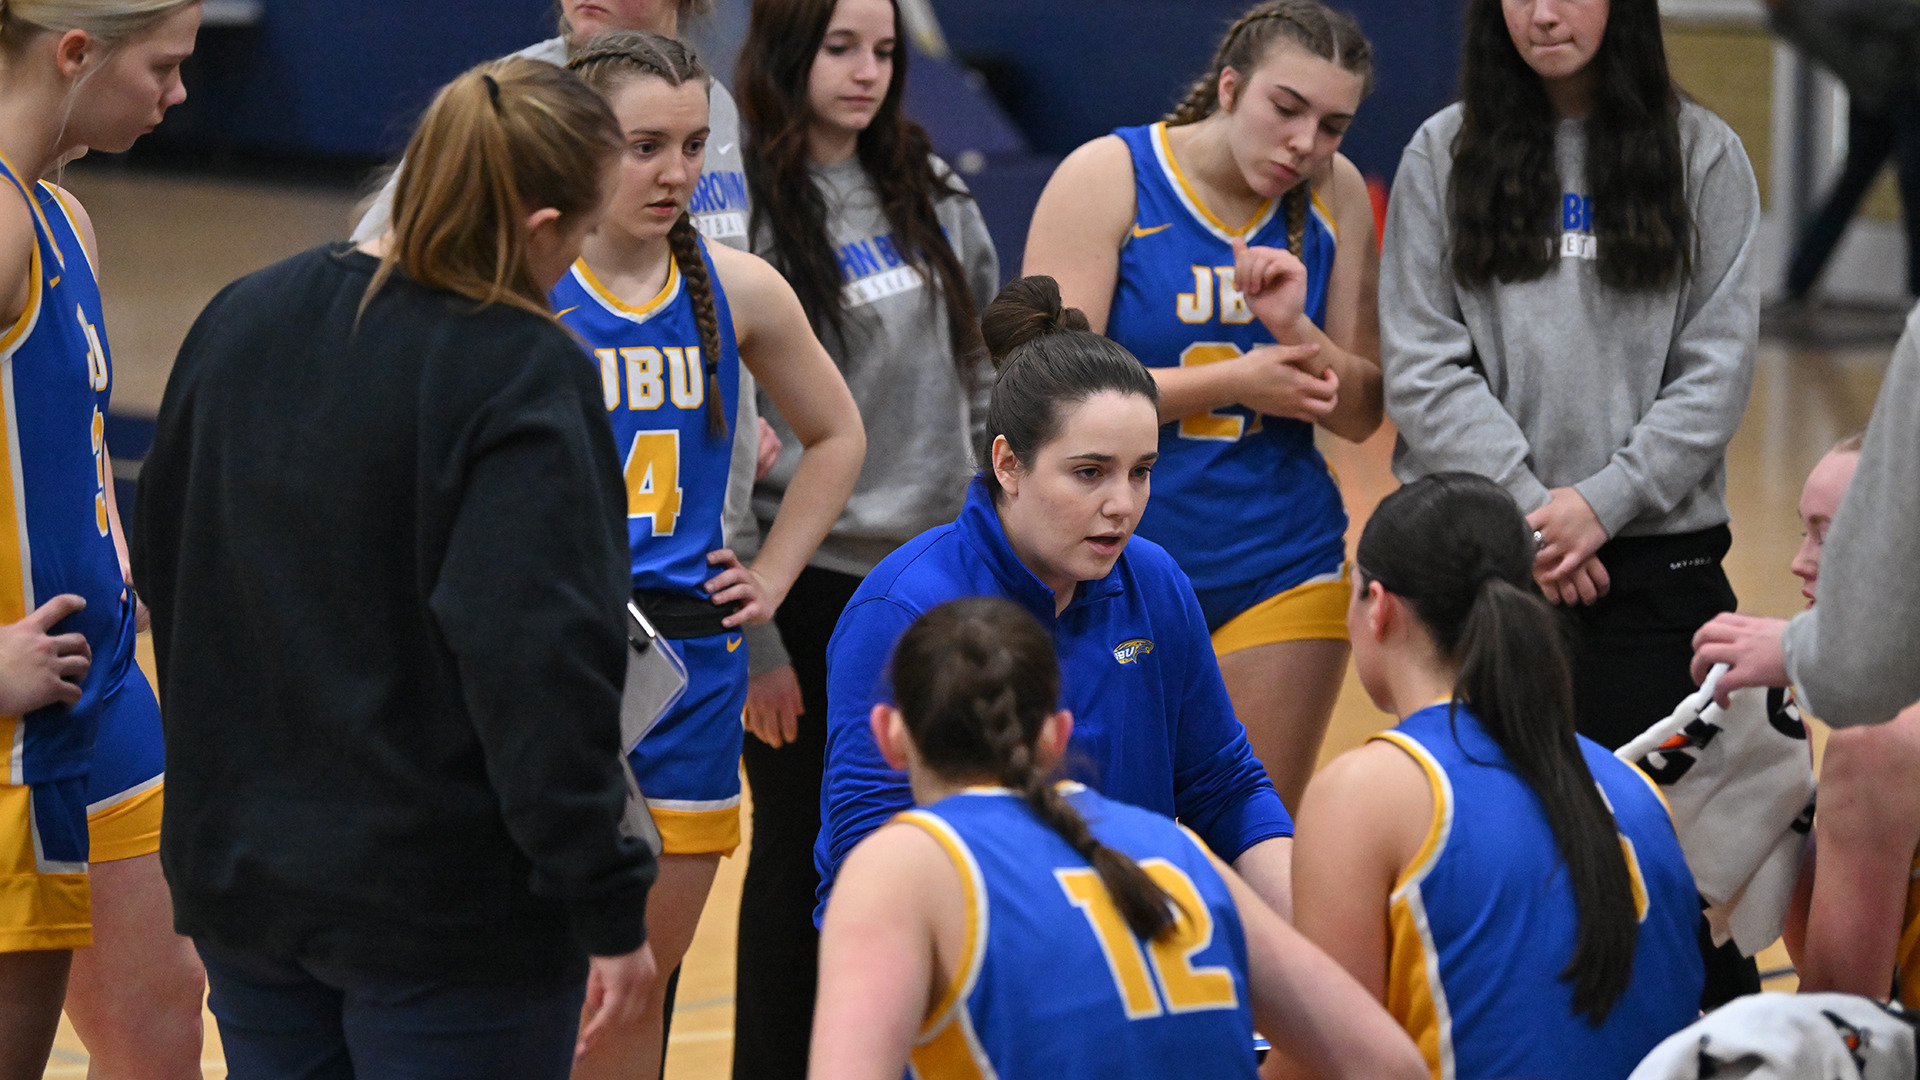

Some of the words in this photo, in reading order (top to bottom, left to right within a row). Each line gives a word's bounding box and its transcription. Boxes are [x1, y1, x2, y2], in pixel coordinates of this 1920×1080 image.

[1176, 264, 1257, 325] JB
[623, 428, 683, 537] 4
[1052, 857, 1240, 1021] 12
